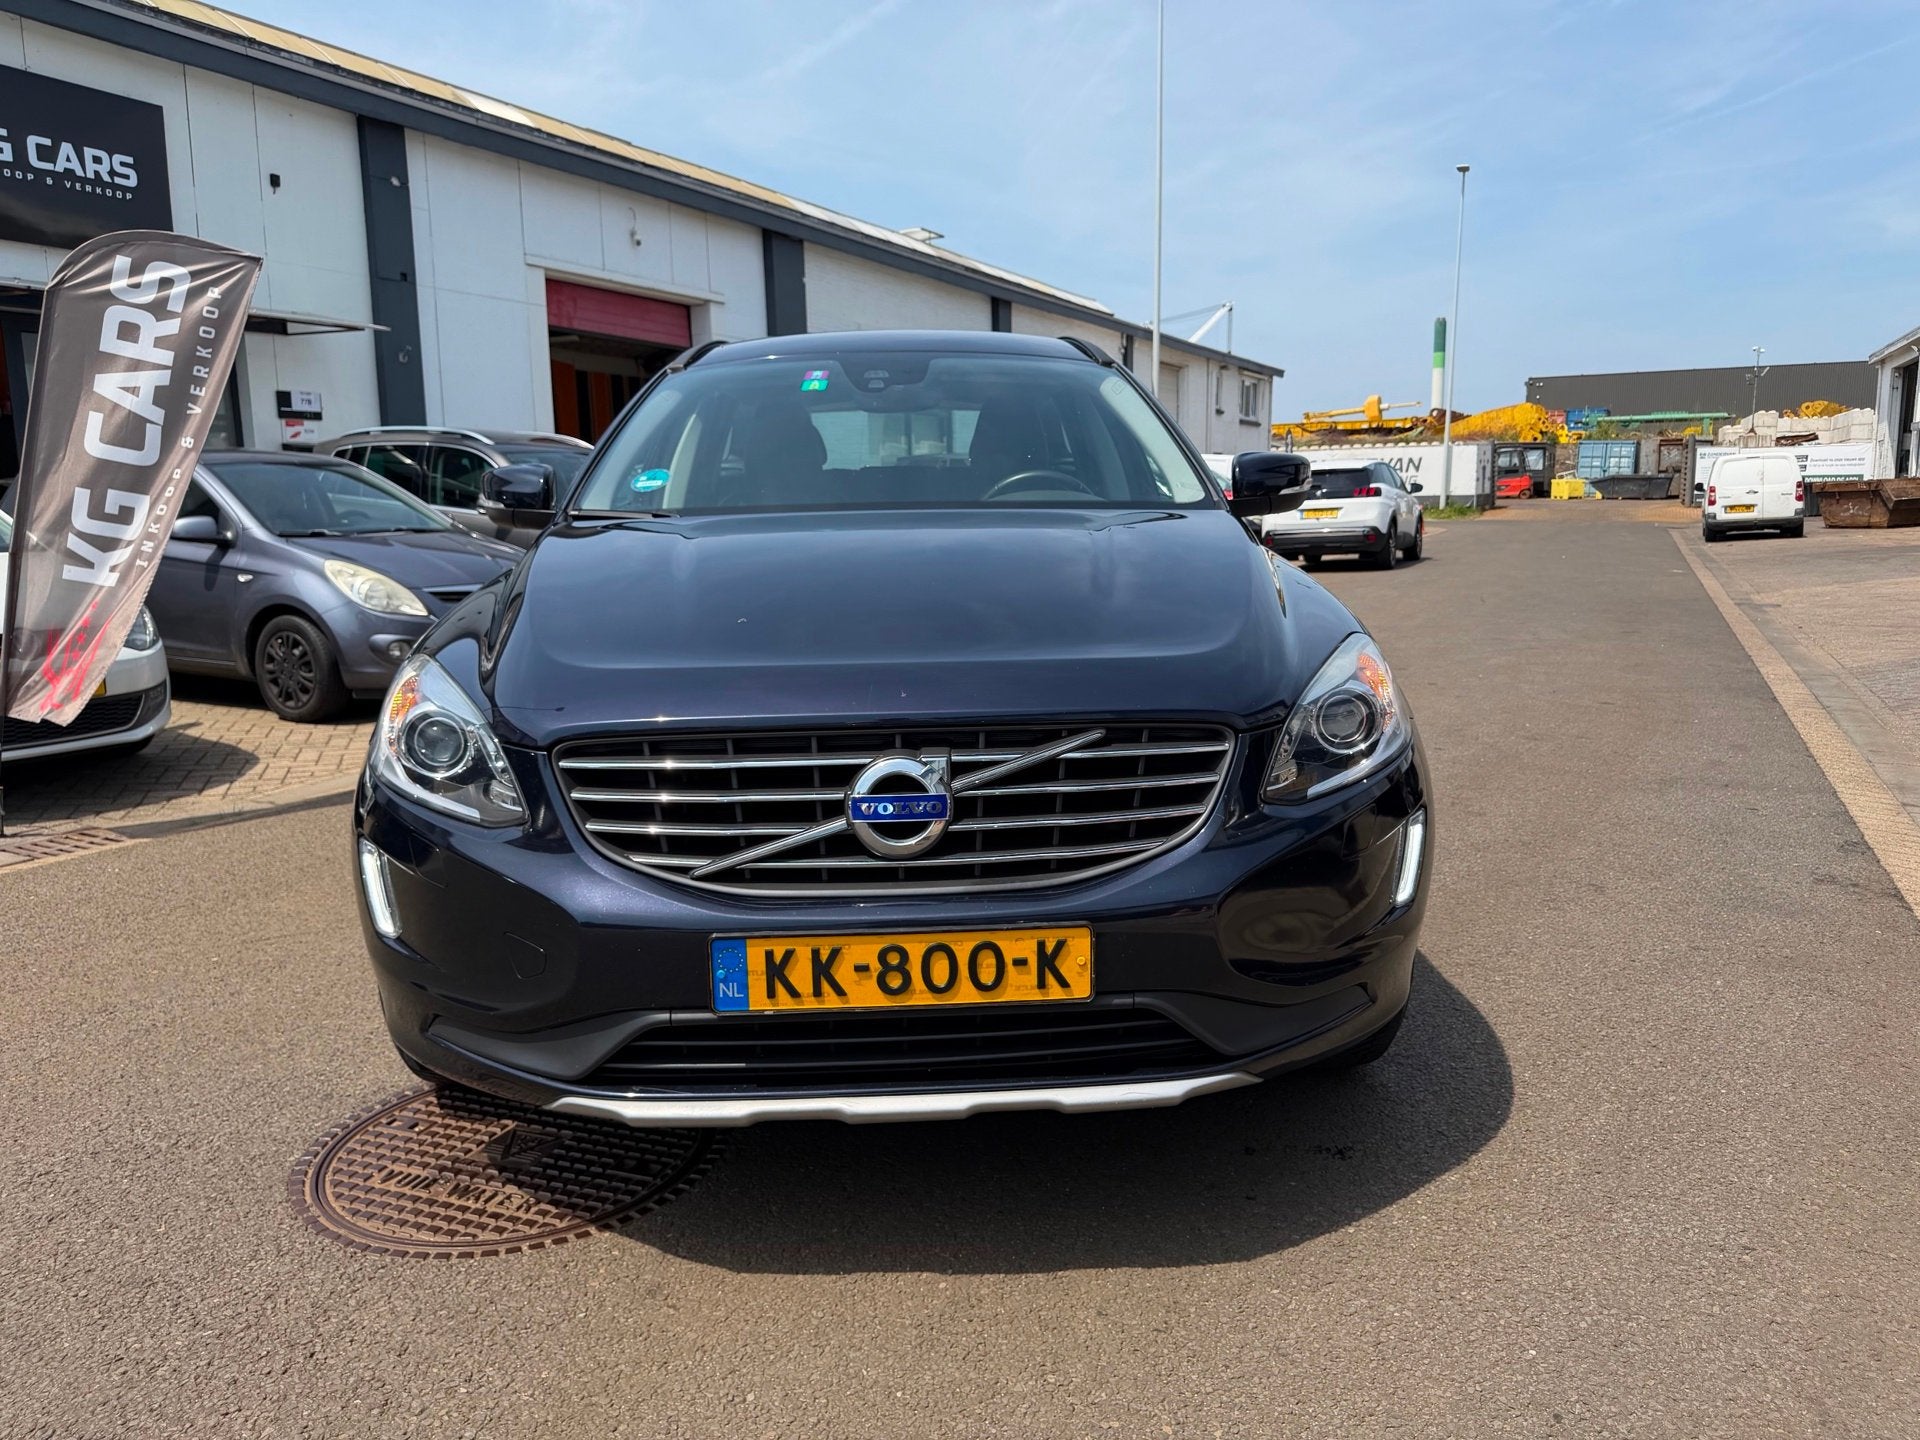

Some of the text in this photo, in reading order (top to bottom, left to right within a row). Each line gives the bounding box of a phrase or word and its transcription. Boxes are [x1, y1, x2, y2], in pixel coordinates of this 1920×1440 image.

[26, 134, 138, 188] CARS
[46, 177, 53, 185] &
[64, 180, 133, 200] VERKOOP
[62, 254, 192, 587] KG CARS
[136, 286, 223, 568] INKOOP & VERKOOP
[857, 801, 942, 815] VOLVO
[719, 982, 744, 998] NL
[764, 938, 1072, 999] KK-800-K
[445, 1182, 538, 1214] WATER
